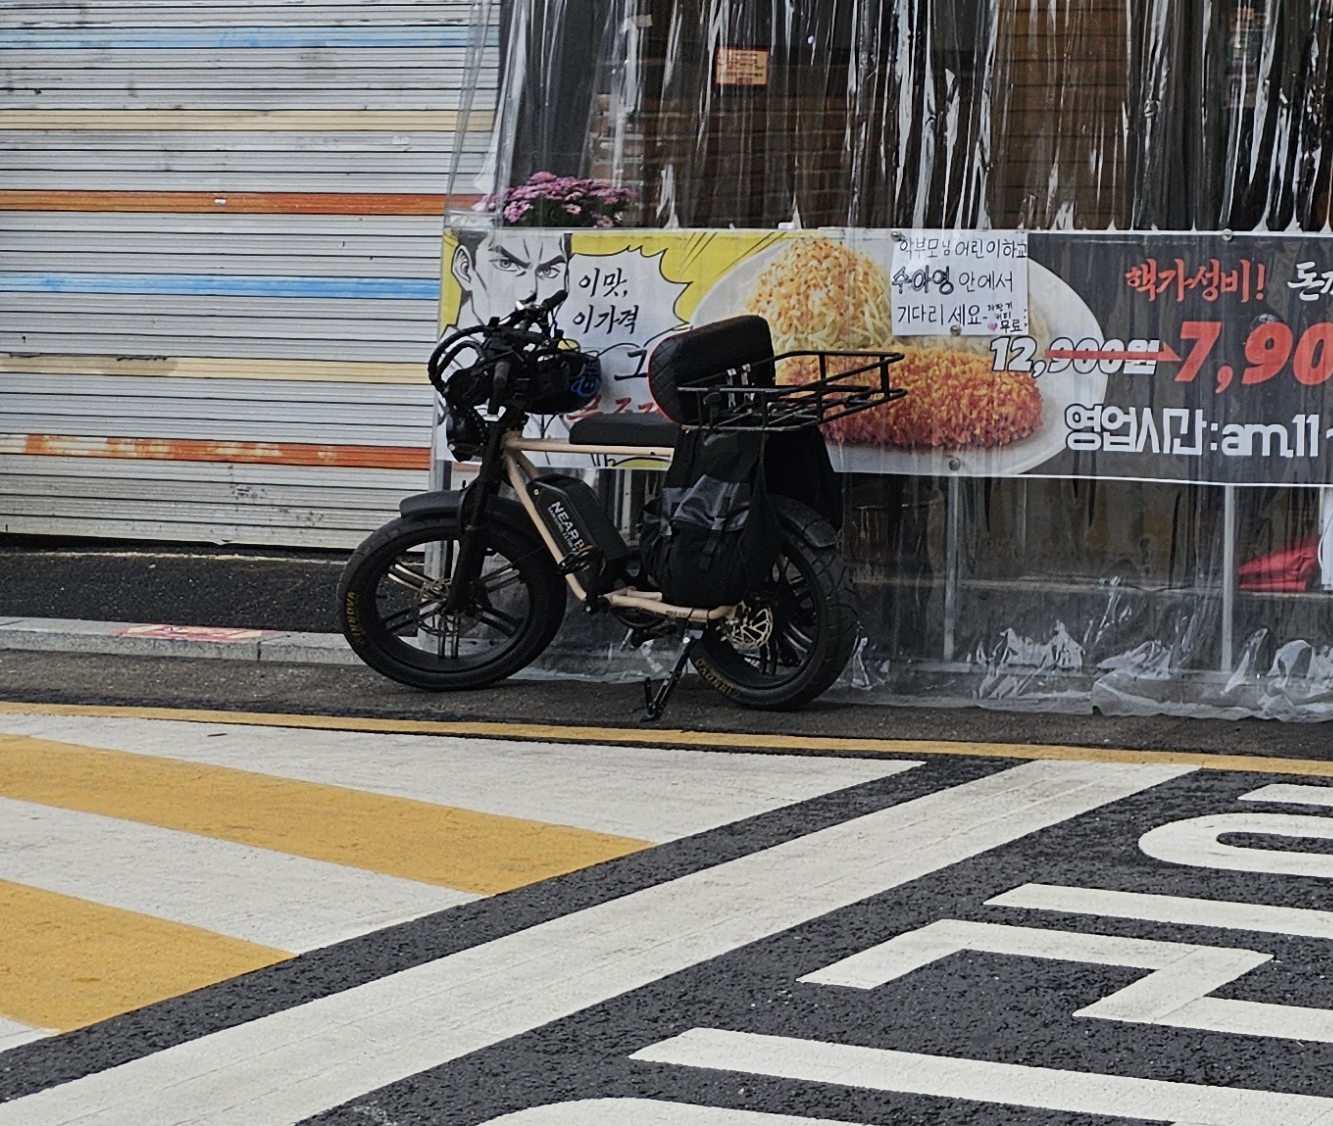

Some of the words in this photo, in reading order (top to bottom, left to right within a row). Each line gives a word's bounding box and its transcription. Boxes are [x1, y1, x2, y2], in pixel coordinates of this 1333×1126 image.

[578, 267, 630, 299] 이맛,
[891, 265, 955, 295] 수아영
[958, 271, 1014, 293] 안에서
[1125, 258, 1266, 304] 핵가성비!
[572, 305, 640, 335] 이가격
[1000, 319, 1023, 334] 무료
